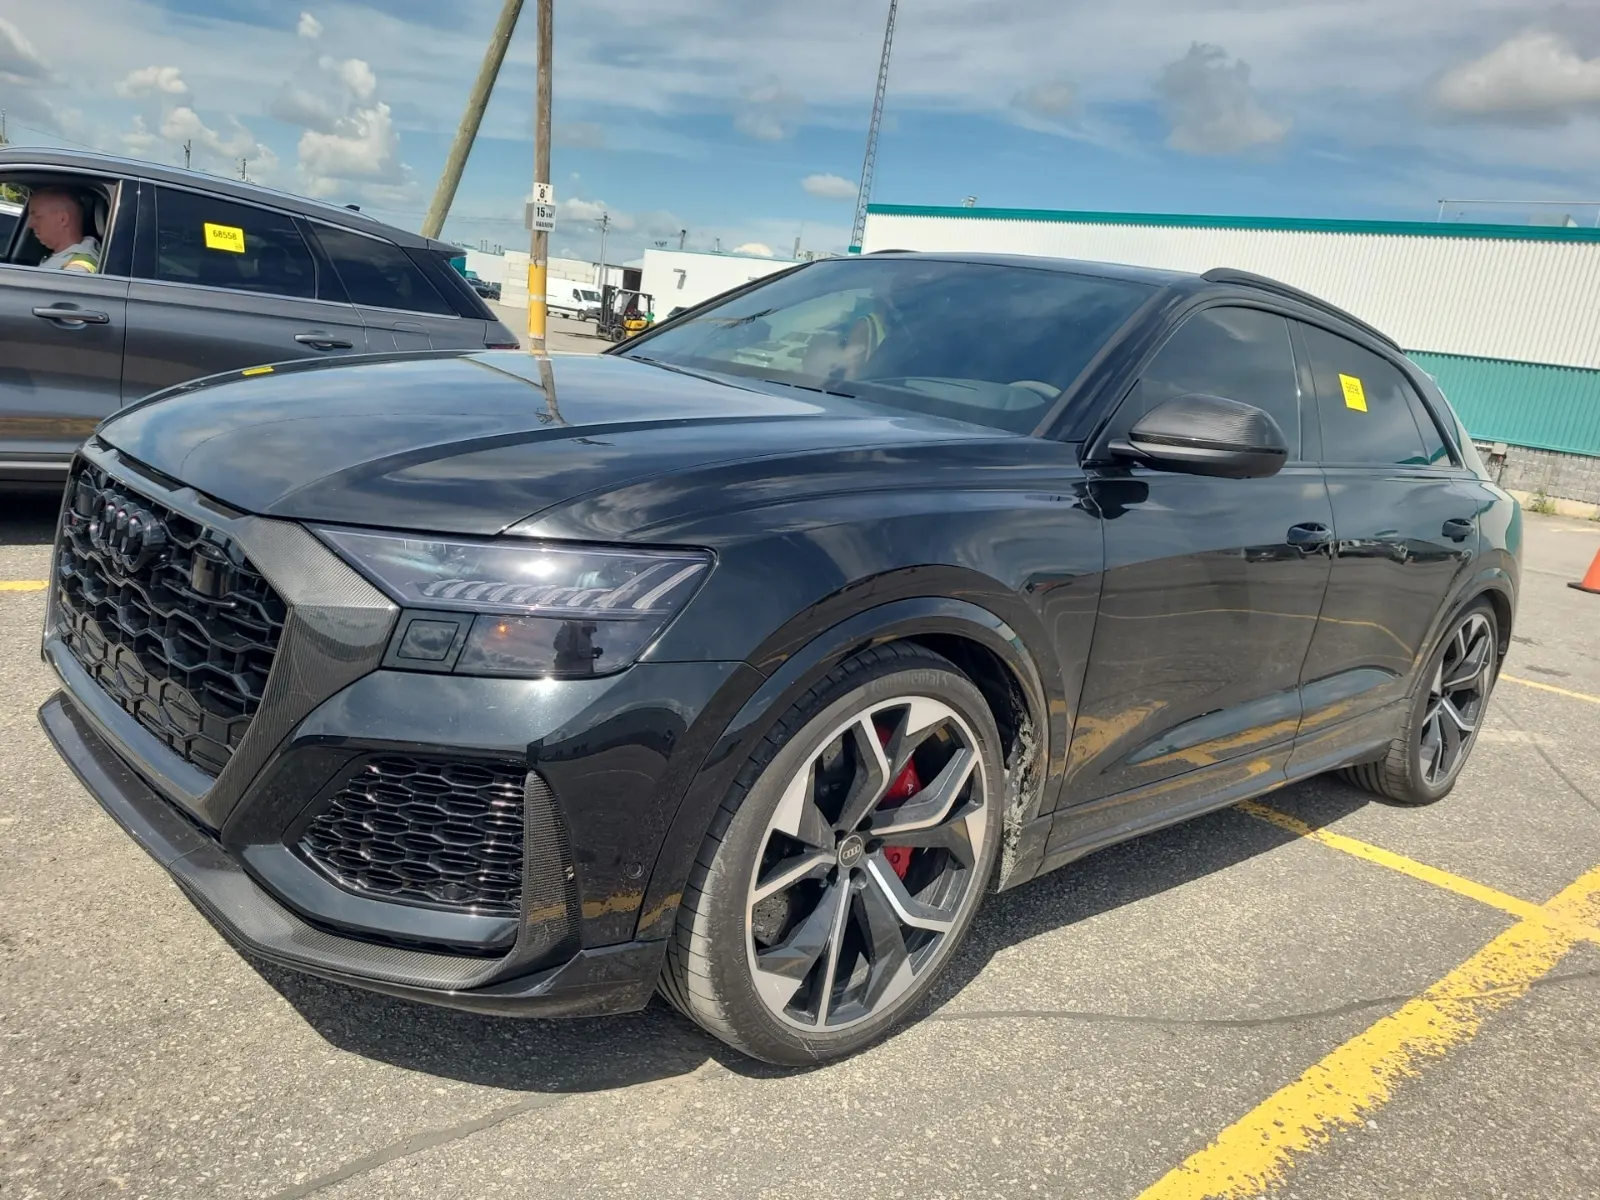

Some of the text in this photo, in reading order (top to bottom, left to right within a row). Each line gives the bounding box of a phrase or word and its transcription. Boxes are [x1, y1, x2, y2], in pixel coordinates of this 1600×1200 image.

[540, 188, 545, 198] 8
[537, 207, 545, 217] 15
[212, 230, 237, 240] 68558
